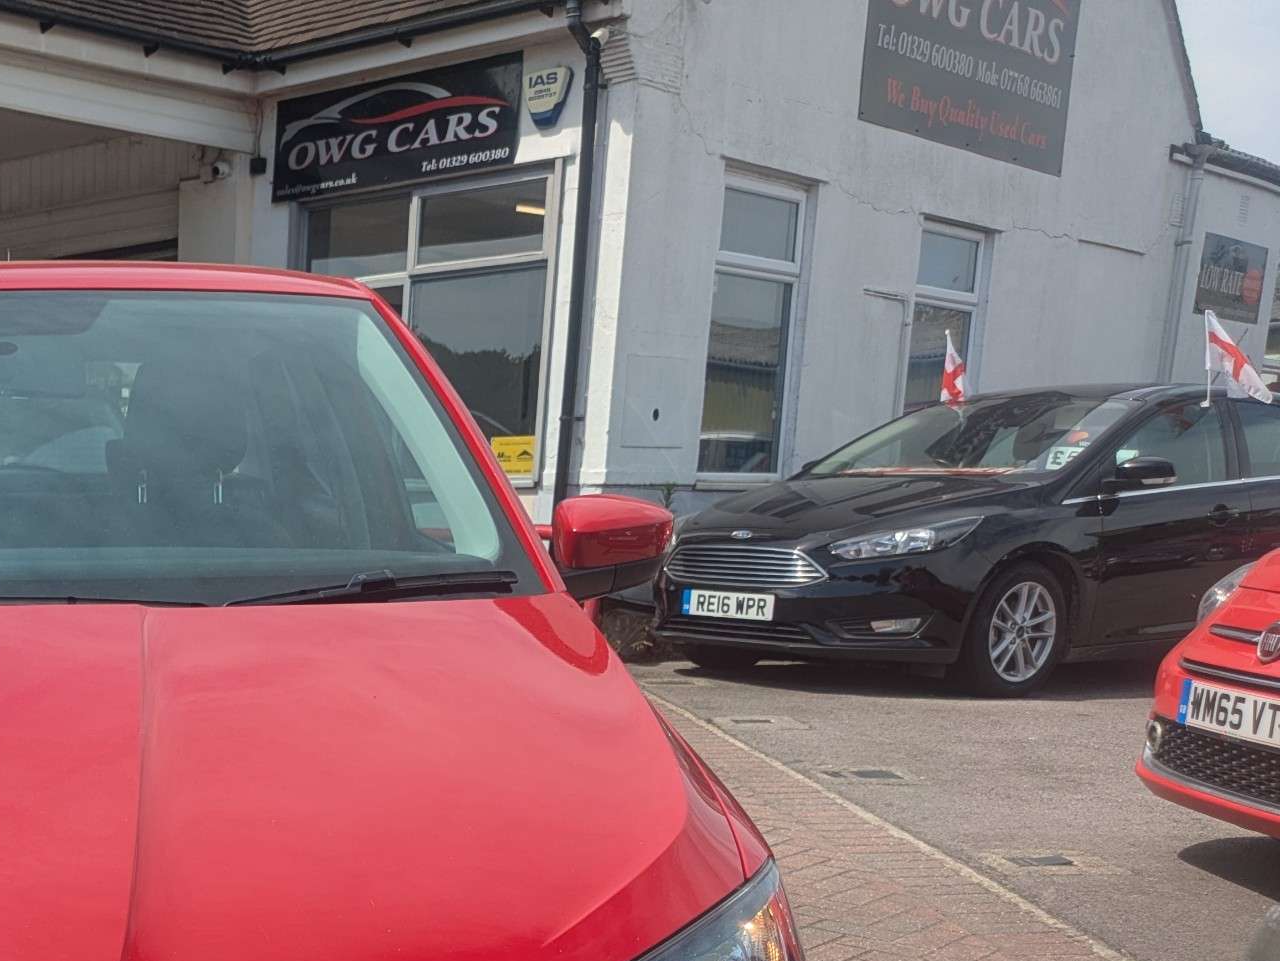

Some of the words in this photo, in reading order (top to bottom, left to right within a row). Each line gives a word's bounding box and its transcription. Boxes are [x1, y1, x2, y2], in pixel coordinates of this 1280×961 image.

[877, 23, 896, 51] Tel:
[898, 32, 930, 63] 01329
[931, 44, 974, 78] 600380
[1000, 68, 1030, 97] 07768
[980, 0, 1065, 63] CARS
[528, 71, 559, 89] IAS
[887, 76, 906, 108] We
[911, 86, 938, 128] Buy
[938, 95, 990, 142] Quality
[990, 110, 1020, 141] Used
[287, 129, 378, 171] OWG
[387, 106, 501, 152] CARS
[421, 158, 438, 172] Tel:
[438, 154, 468, 170] 01329
[468, 147, 510, 164] 600380
[696, 594, 731, 614] RE16
[735, 596, 767, 617] WPR
[1190, 686, 1246, 731] WM65
[1252, 699, 1280, 739] VT
